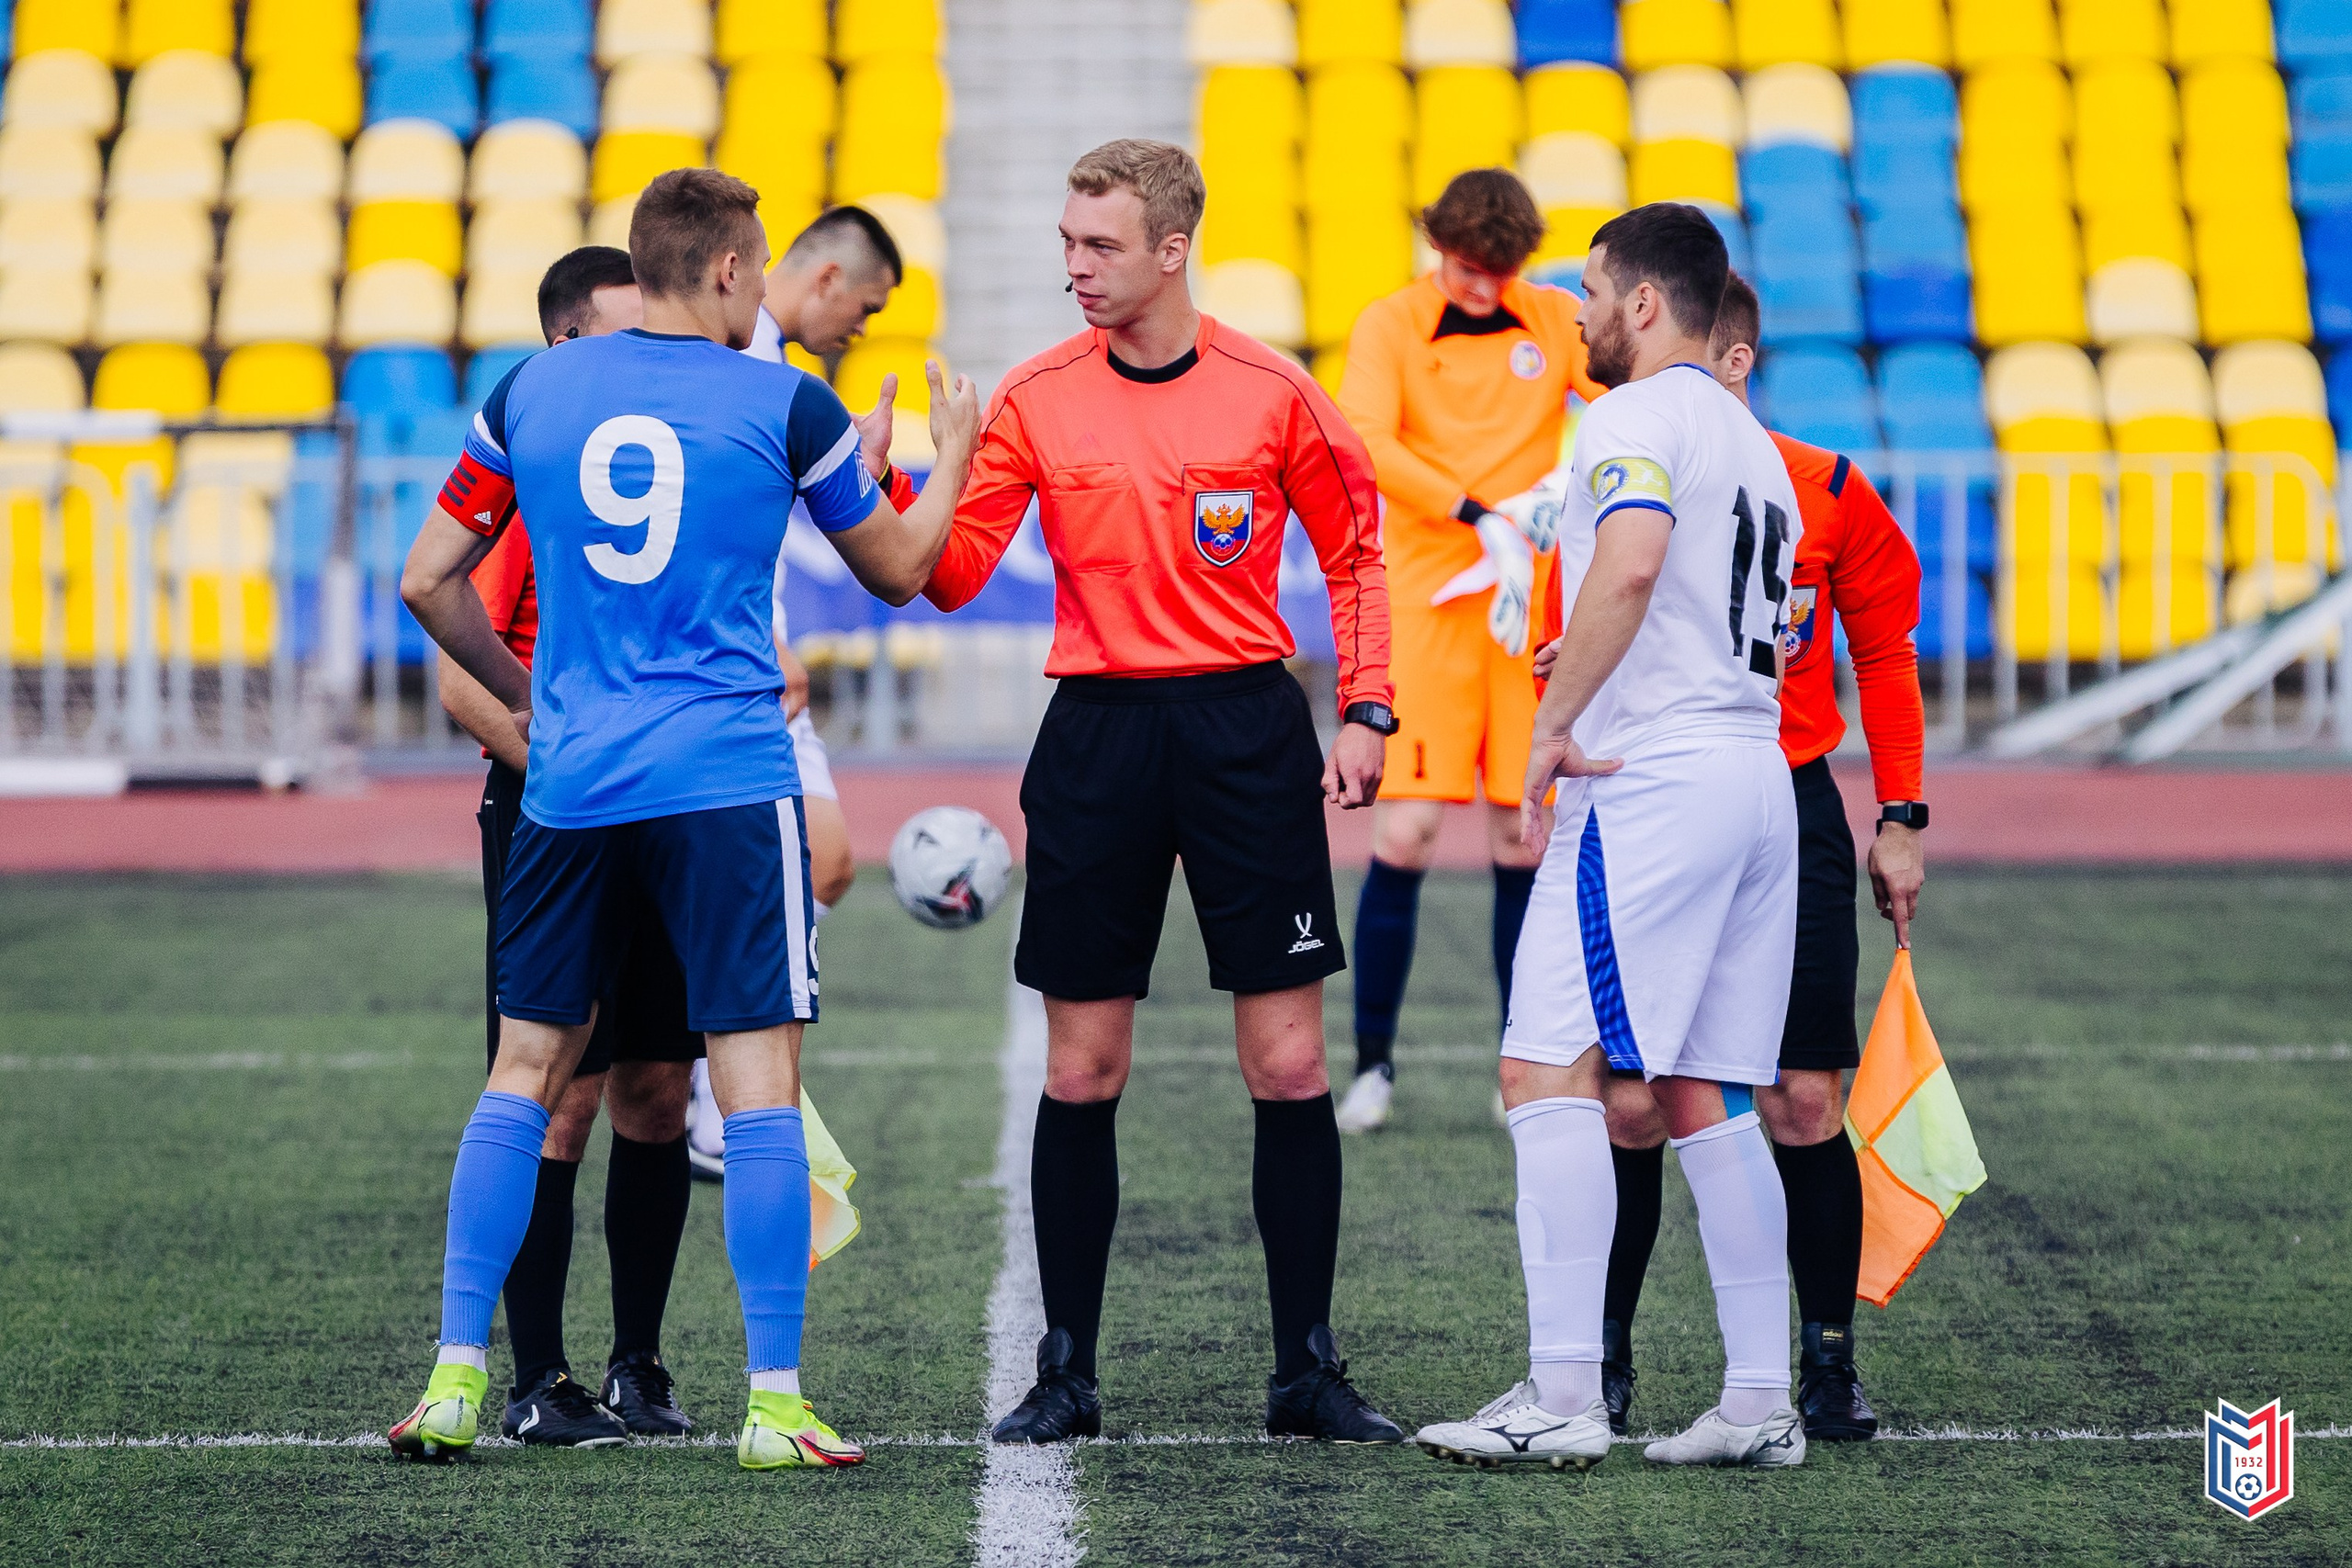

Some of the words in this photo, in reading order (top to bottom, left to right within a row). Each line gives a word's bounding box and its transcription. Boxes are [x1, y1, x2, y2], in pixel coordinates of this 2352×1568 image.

[580, 414, 684, 584] 9
[1729, 484, 1790, 680] 15
[1287, 939, 1325, 954] JÖGEL
